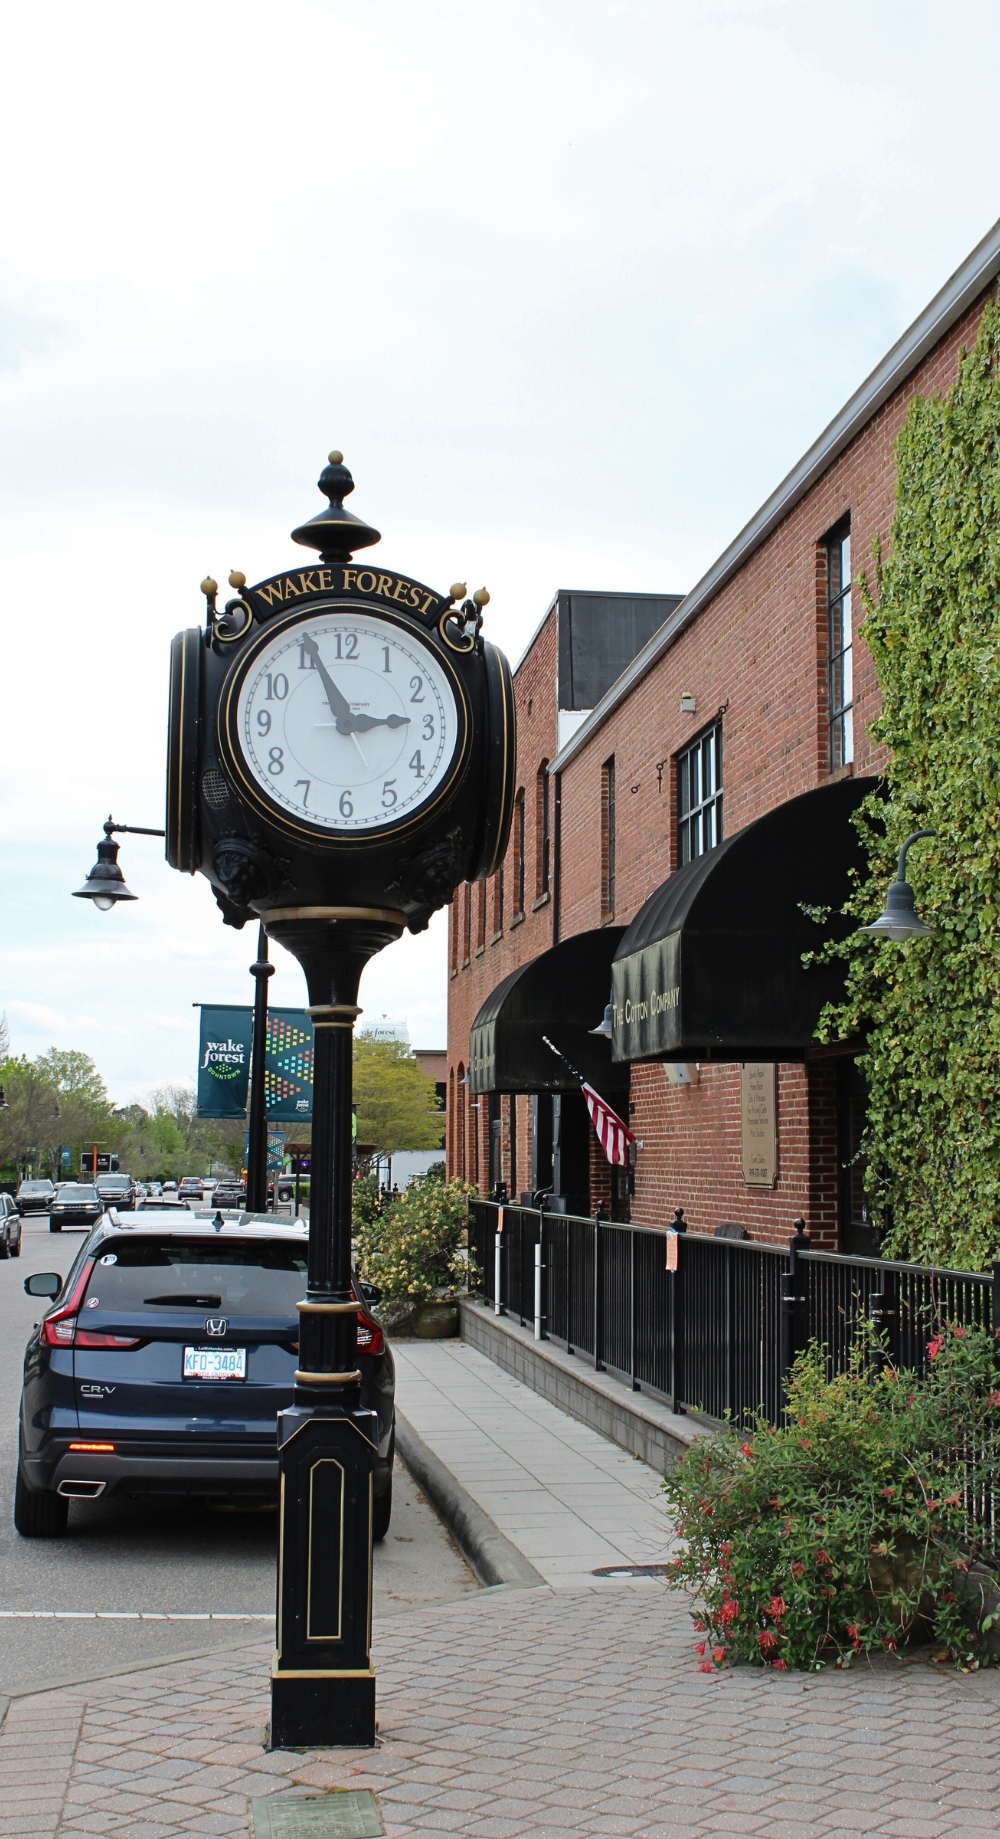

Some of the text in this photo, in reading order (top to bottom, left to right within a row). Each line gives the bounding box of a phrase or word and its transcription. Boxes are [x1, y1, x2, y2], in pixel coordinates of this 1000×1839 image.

[255, 569, 439, 615] WAKE FOREST
[334, 633, 360, 660] 12
[382, 646, 392, 673] 1
[265, 673, 289, 700] 10
[410, 676, 426, 703] 2
[257, 709, 272, 737] 9
[422, 714, 435, 741] 3
[267, 746, 284, 775] 8
[409, 749, 425, 778] 4
[294, 779, 311, 808] 7
[339, 790, 354, 818] 6
[381, 778, 398, 807] 5
[612, 987, 680, 1028] THE COTTON COMPANY
[206, 1038, 244, 1052] wake
[374, 1028, 395, 1038] forest
[200, 1049, 245, 1069] forest
[207, 1066, 241, 1080] DOWNTOWN
[185, 1354, 243, 1371] KFD-3484
[80, 1384, 117, 1394] CR-V
